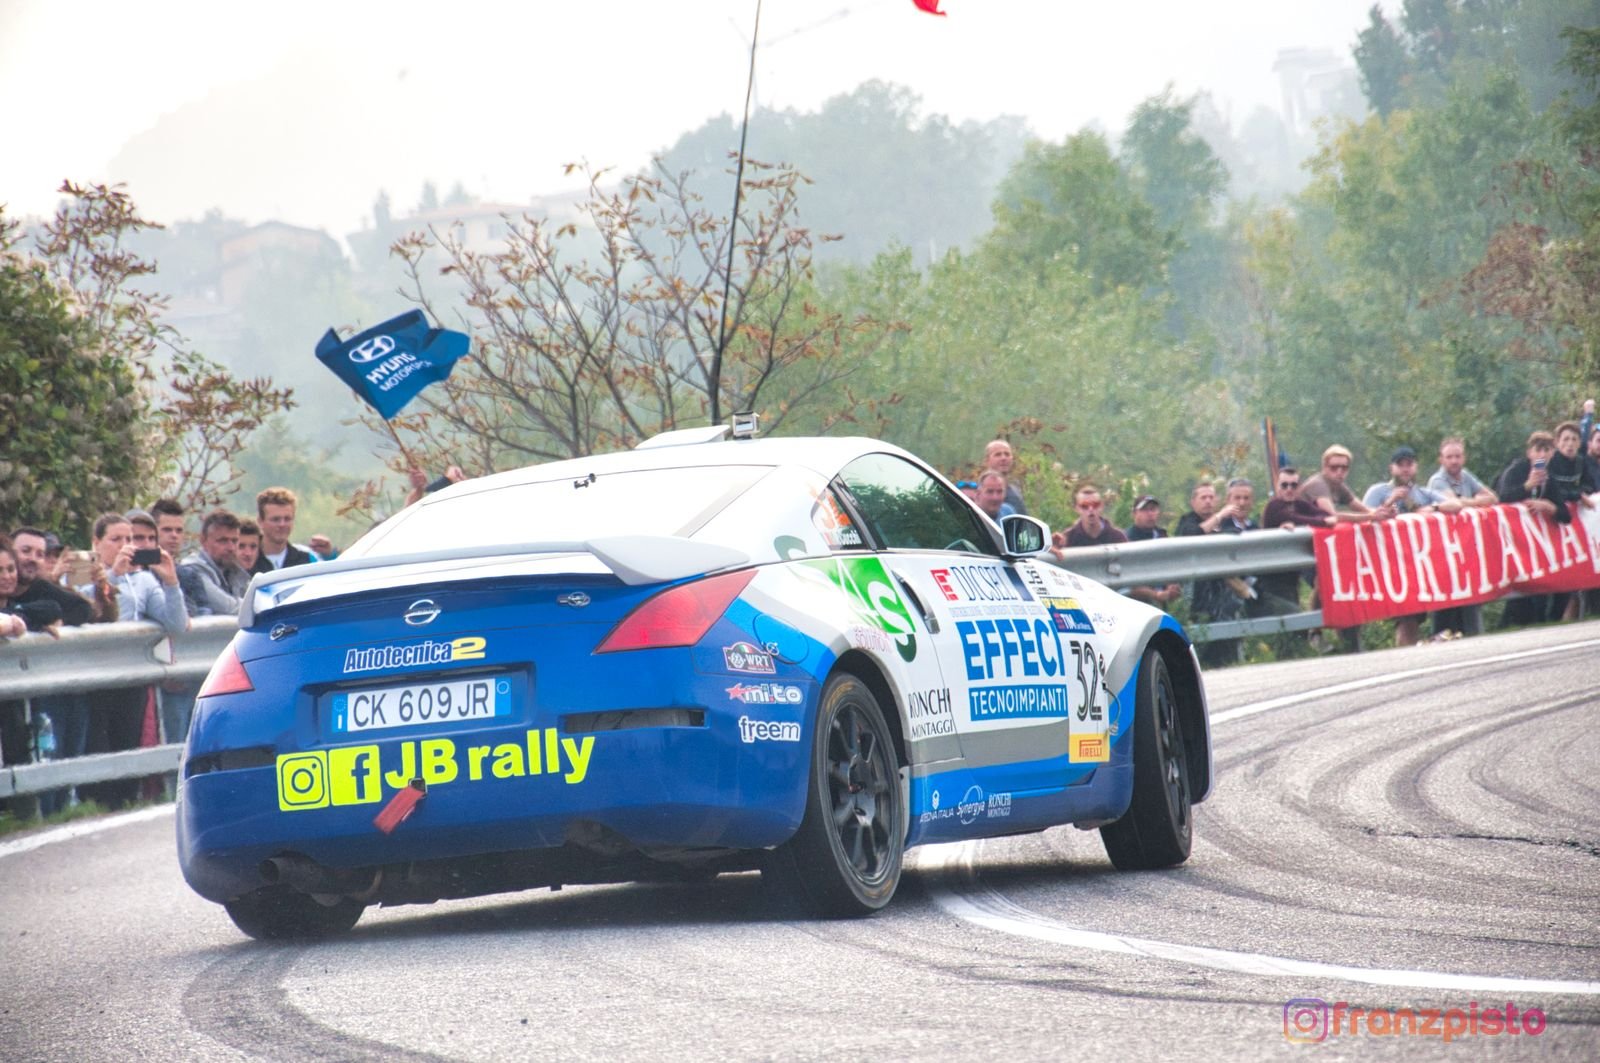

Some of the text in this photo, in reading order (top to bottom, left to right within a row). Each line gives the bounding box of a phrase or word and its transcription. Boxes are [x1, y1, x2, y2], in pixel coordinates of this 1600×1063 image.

[1324, 503, 1588, 603] LAURETANA
[745, 654, 770, 668] WRT
[955, 618, 1066, 681] EFFECI
[1069, 640, 1103, 722] 32
[353, 693, 387, 727] CK
[399, 686, 452, 722] 609
[458, 682, 489, 717] JR
[908, 687, 952, 719] RONCHI
[971, 687, 1067, 716] TECNOIMPIANTI
[739, 716, 801, 743] freem
[911, 719, 954, 739] MONTAGGI
[384, 738, 459, 790] JB
[467, 727, 596, 785] rally
[1079, 738, 1103, 759] PIRELLI
